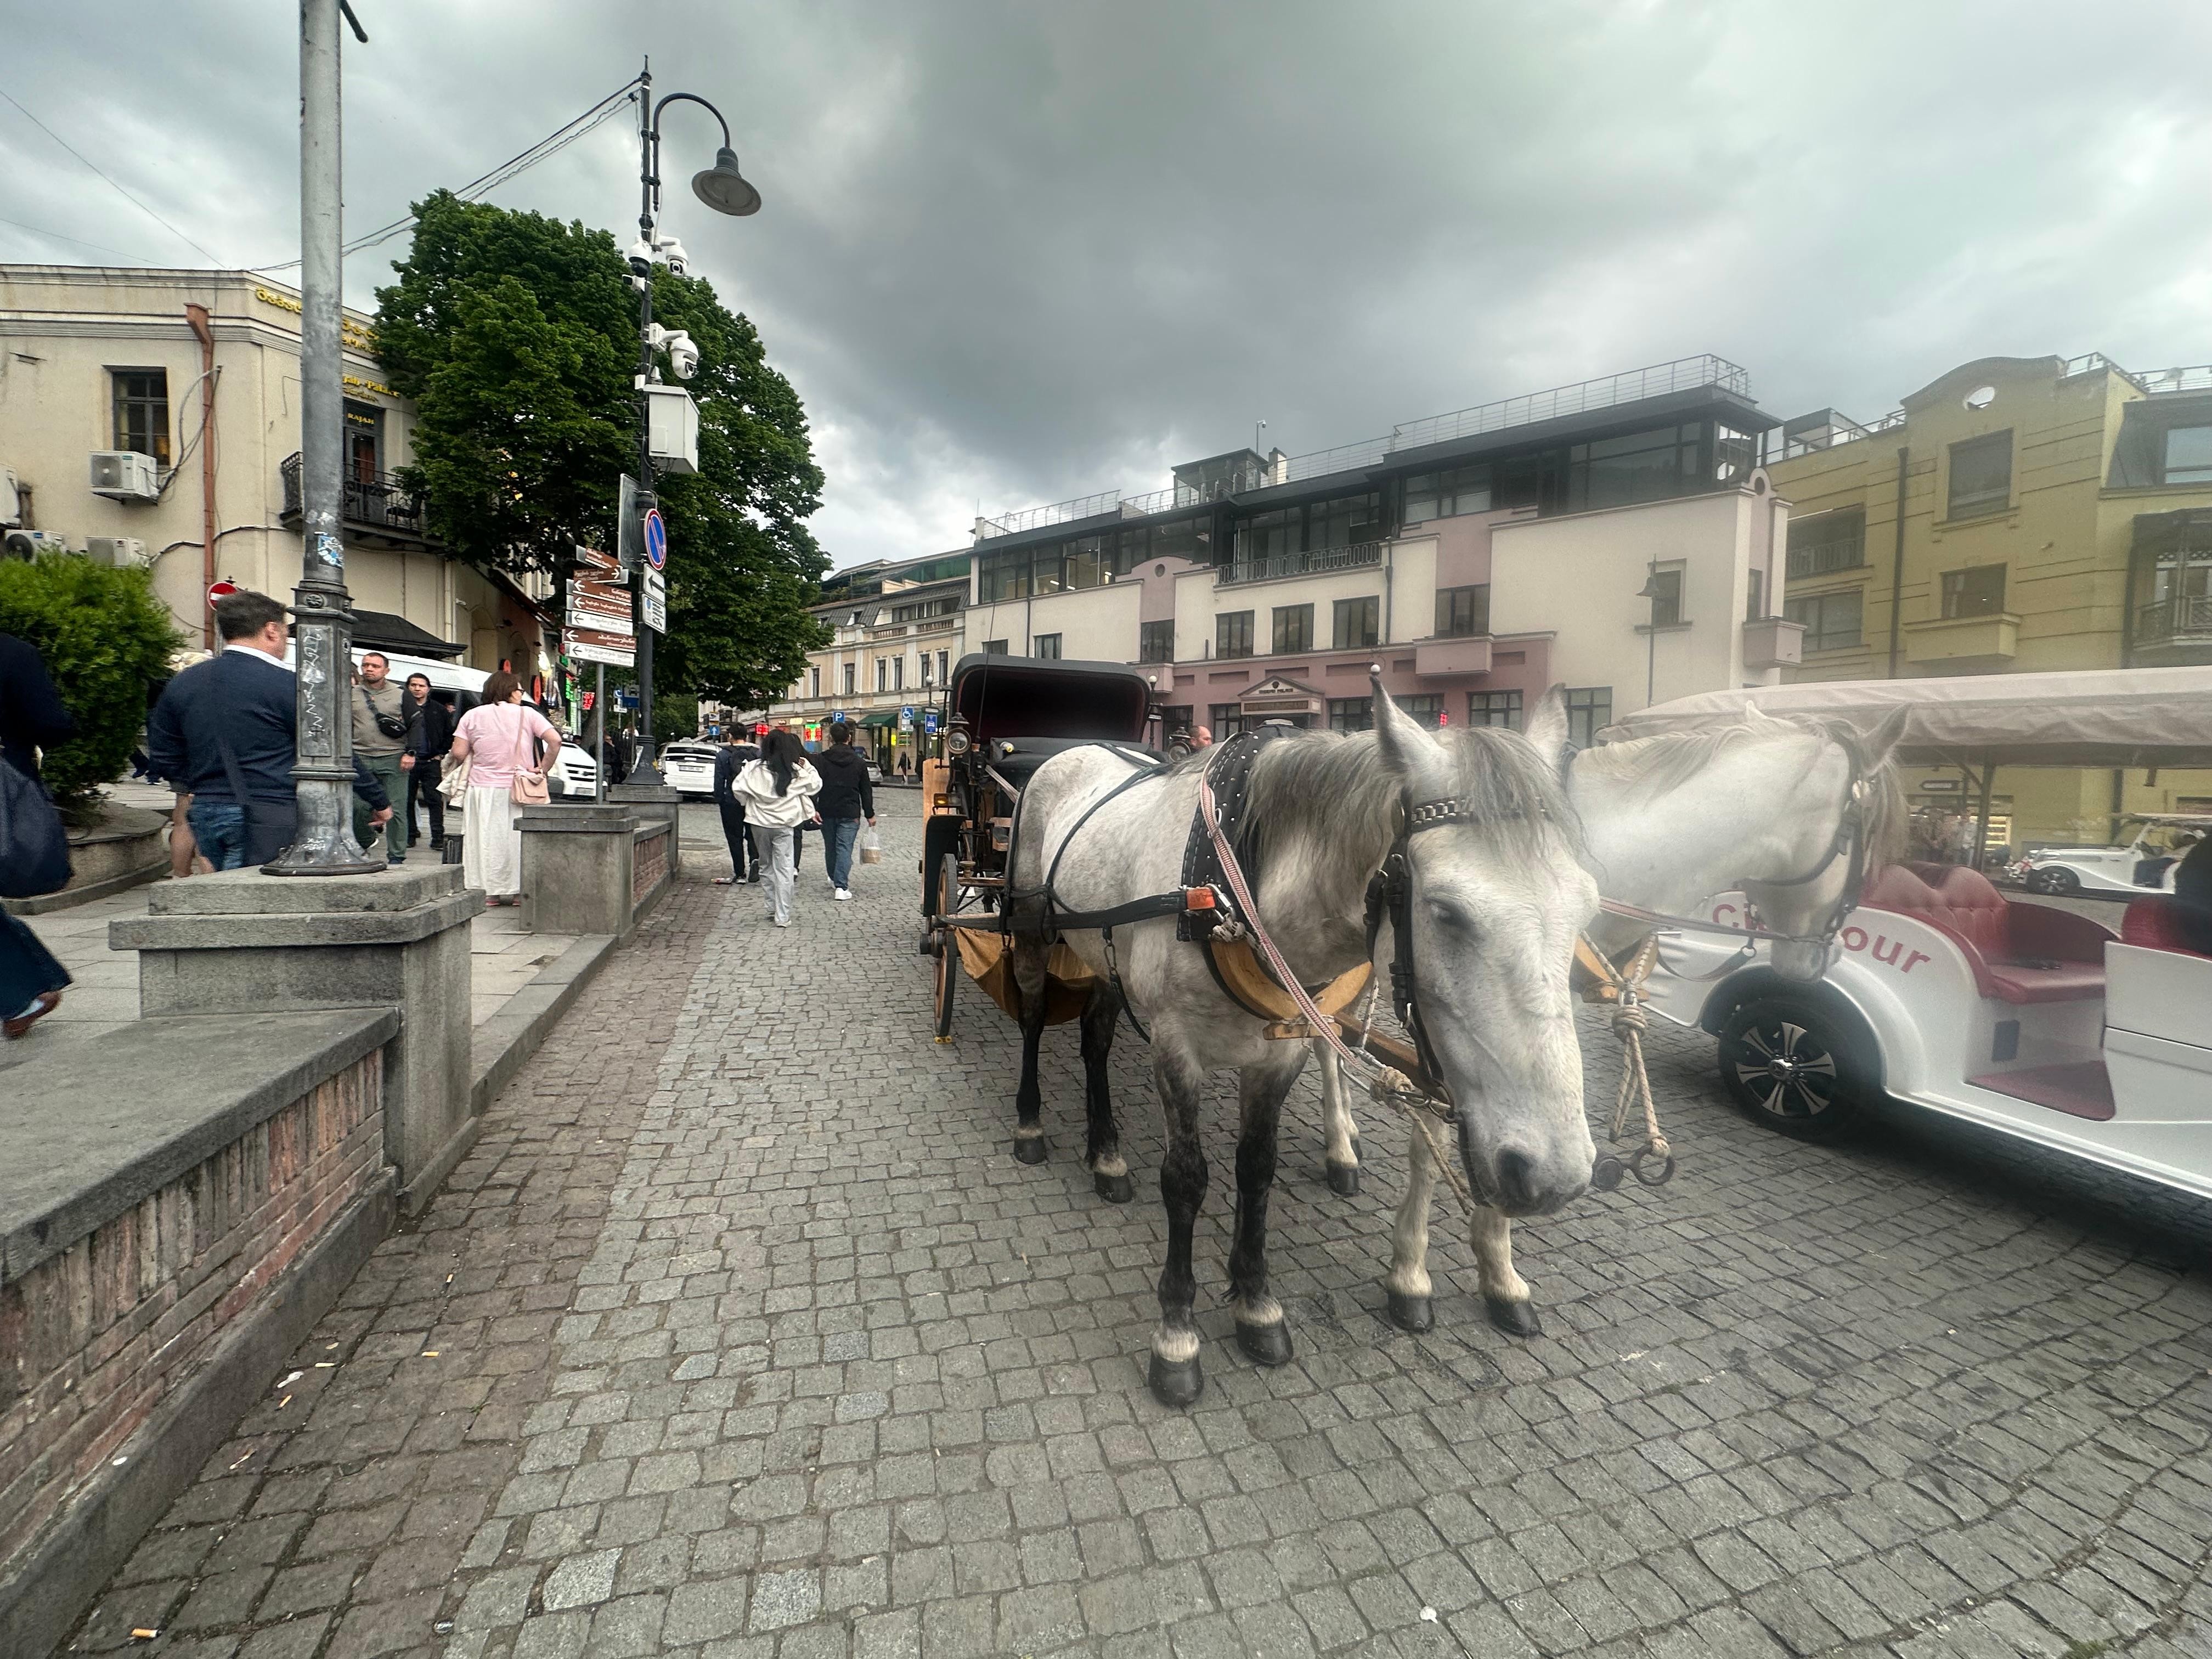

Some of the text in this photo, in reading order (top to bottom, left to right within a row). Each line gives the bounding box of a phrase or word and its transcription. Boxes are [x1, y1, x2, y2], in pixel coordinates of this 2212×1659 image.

[347, 413, 375, 425] RAJAH
[835, 713, 843, 721] P
[1841, 926, 1932, 973] our
